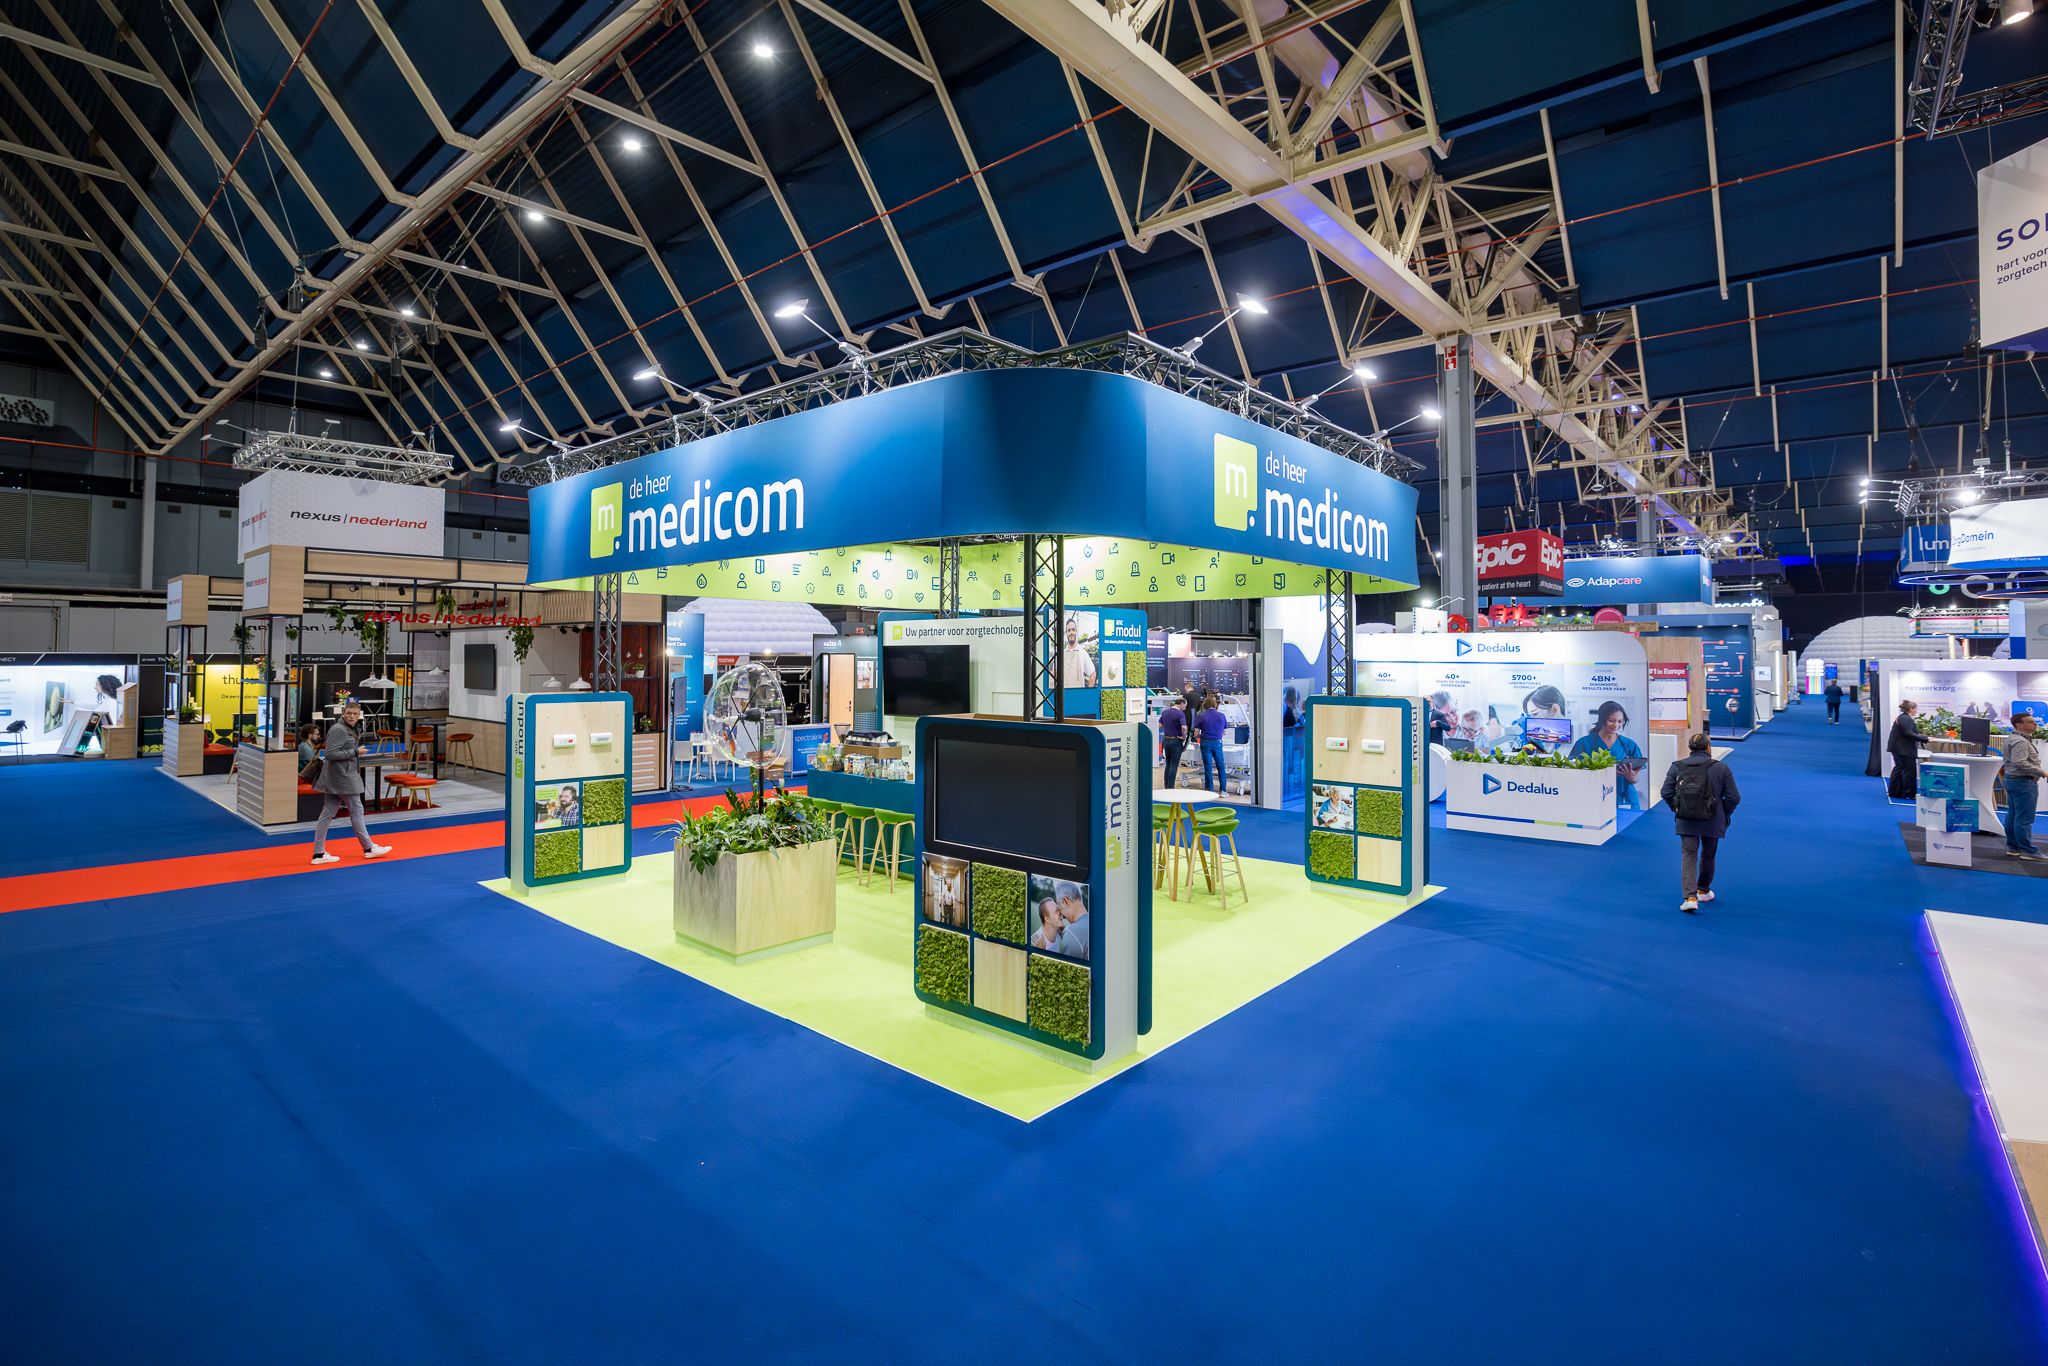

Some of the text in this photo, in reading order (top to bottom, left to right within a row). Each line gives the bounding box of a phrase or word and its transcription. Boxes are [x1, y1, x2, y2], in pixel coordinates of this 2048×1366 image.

[1996, 257, 2019, 273] hart
[1265, 450, 1308, 484] de heer
[629, 474, 672, 500] de heer
[290, 509, 428, 530] nexus nederland
[628, 477, 805, 553] medicom
[1265, 487, 1389, 562] medicom
[1540, 537, 1562, 571] Epic
[1482, 582, 1499, 592] patient
[1500, 581, 1506, 589] at
[1506, 580, 1516, 589] the
[1516, 579, 1532, 588] heart
[1587, 576, 1643, 587] Adapcare
[363, 611, 542, 627] nexus nederland
[1488, 603, 1540, 624] Epic
[905, 627, 917, 637] Uw
[918, 627, 945, 639] partner
[947, 627, 964, 637] voor
[1115, 624, 1142, 638] modul
[1477, 642, 1521, 653] Dedalus
[1663, 667, 1686, 676] Europe
[1905, 685, 1956, 693] netwerkzorg
[1126, 755, 1131, 765] de
[1106, 737, 1122, 829] modul
[1507, 781, 1559, 796] Dedalus
